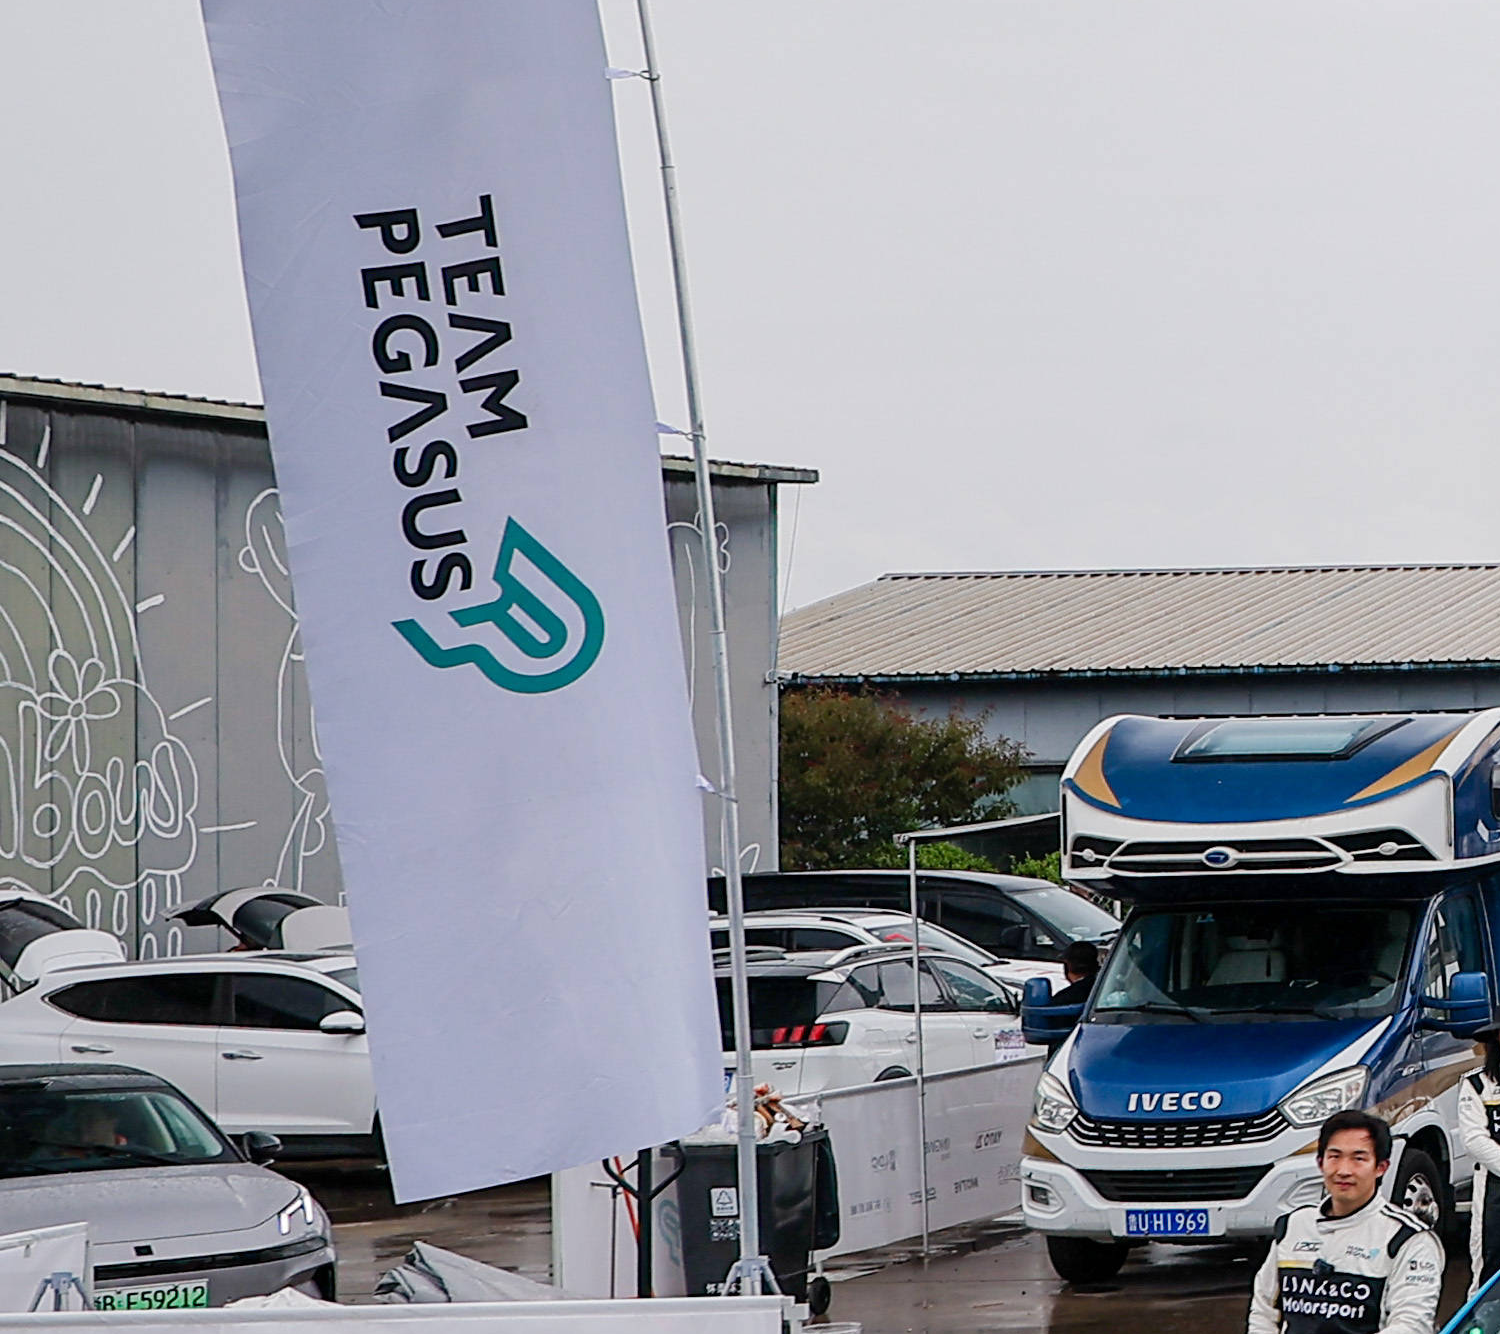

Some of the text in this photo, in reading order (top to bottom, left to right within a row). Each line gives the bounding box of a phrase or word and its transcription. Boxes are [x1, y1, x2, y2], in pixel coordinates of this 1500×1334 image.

[435, 194, 529, 439] TEAM
[353, 208, 473, 601] PEGASUS
[1128, 1091, 1222, 1112] IVECO
[1282, 1276, 1370, 1300] LYNK&CO
[1282, 1297, 1365, 1320] Motorsport
